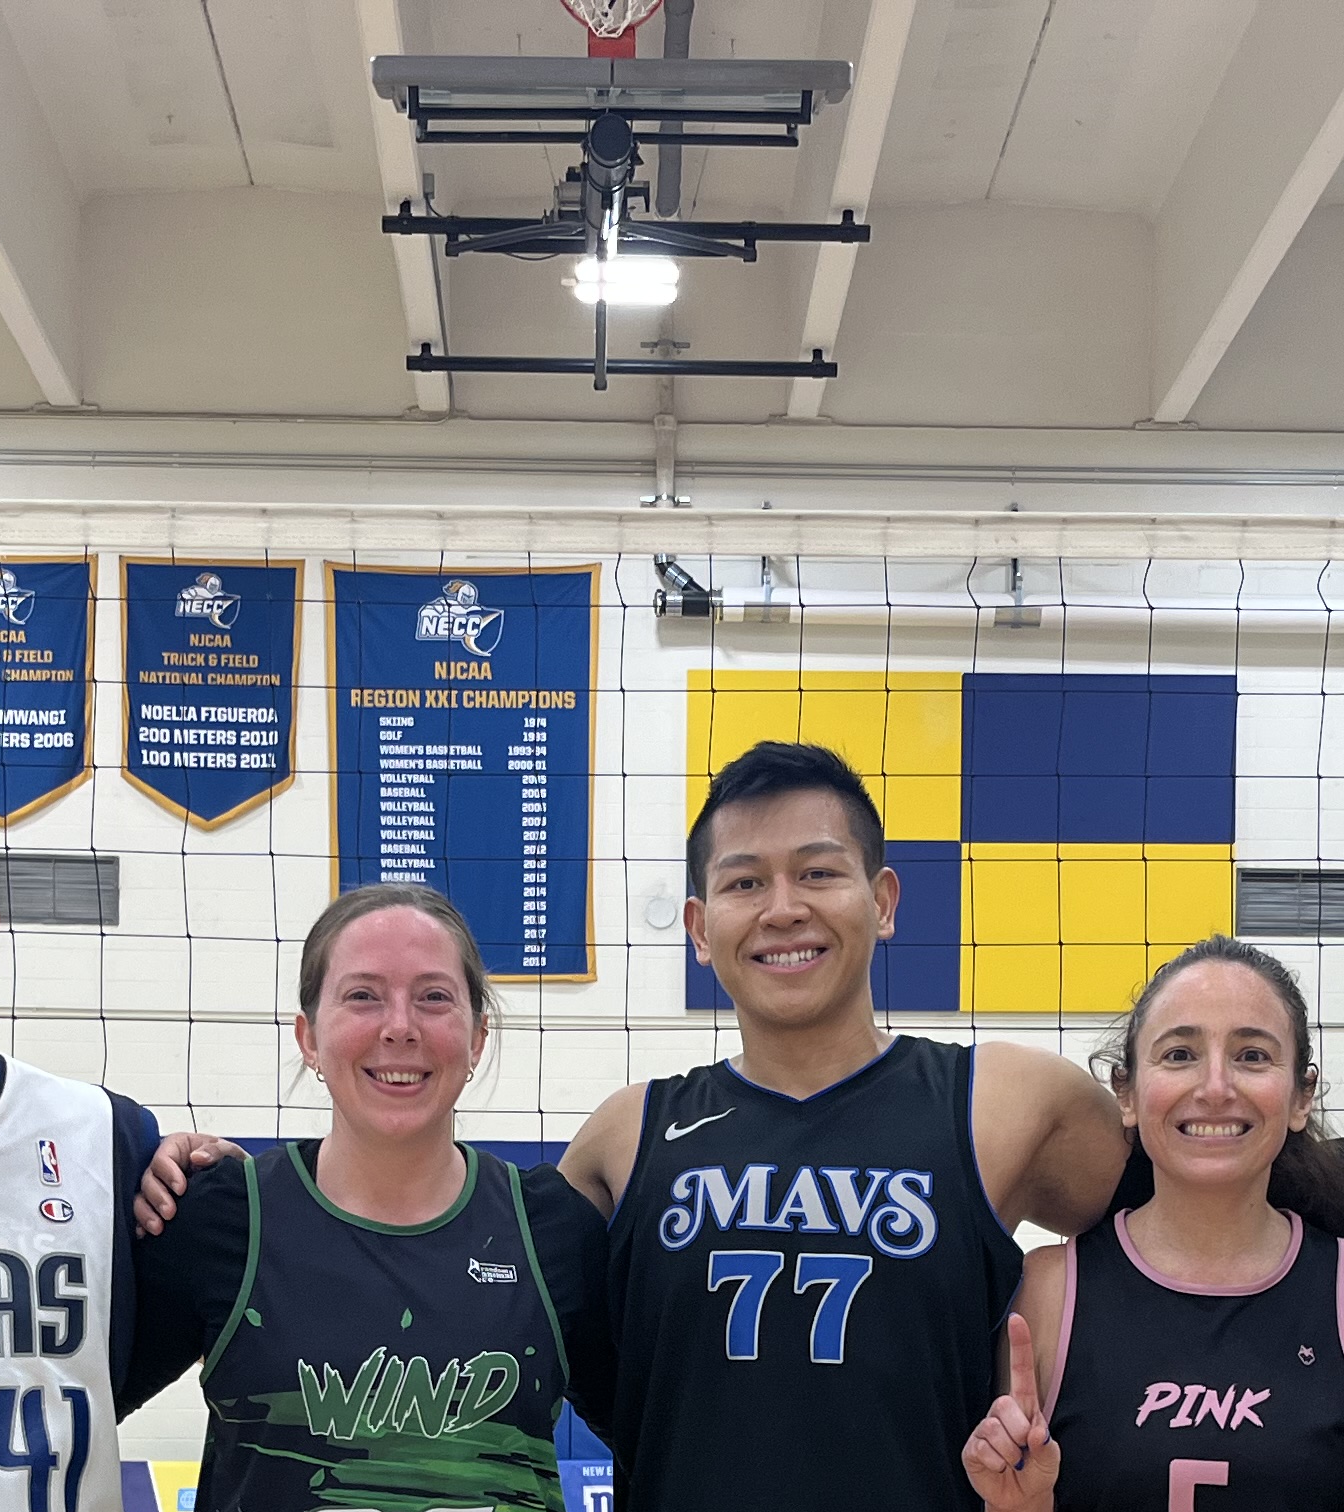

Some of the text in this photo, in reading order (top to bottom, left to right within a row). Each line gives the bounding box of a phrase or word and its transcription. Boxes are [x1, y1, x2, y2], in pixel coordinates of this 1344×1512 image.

[421, 615, 482, 637] NECC
[190, 633, 232, 648] NJCAA
[15, 650, 53, 663] FIELD
[162, 652, 259, 668] TRACK & FIELD
[2, 668, 74, 682] CHAMPION
[434, 660, 492, 681] NJCAA
[139, 670, 281, 687] NATIONAL CHAMPION
[350, 688, 576, 710] REGION XXI CHAMPIONS
[140, 704, 278, 724] NOELIA FIGUEROA
[379, 716, 415, 728] SKIING
[34, 732, 74, 749] 2006
[138, 726, 279, 747] 200 METERS 2010
[380, 730, 403, 742] GOLF
[425, 744, 482, 756] BASKETBALL
[141, 750, 170, 767] 100
[174, 752, 237, 768] METERS
[425, 759, 482, 770] BASKETBALL
[380, 774, 435, 784] VOLLEYBALL
[380, 788, 426, 798] BASEBALL
[380, 802, 435, 812] VOLLEYBALL
[380, 816, 435, 826] VOLLEYBALL
[380, 830, 435, 840] VOLLEYBALL
[380, 844, 426, 854] BASEBALL
[380, 858, 436, 868] VOLLEYBALL
[659, 1165, 938, 1259] MAVS
[706, 1250, 873, 1364] 77
[297, 1346, 521, 1440] WIND
[1134, 1381, 1272, 1430] PINK
[582, 1466, 605, 1477] NEW
